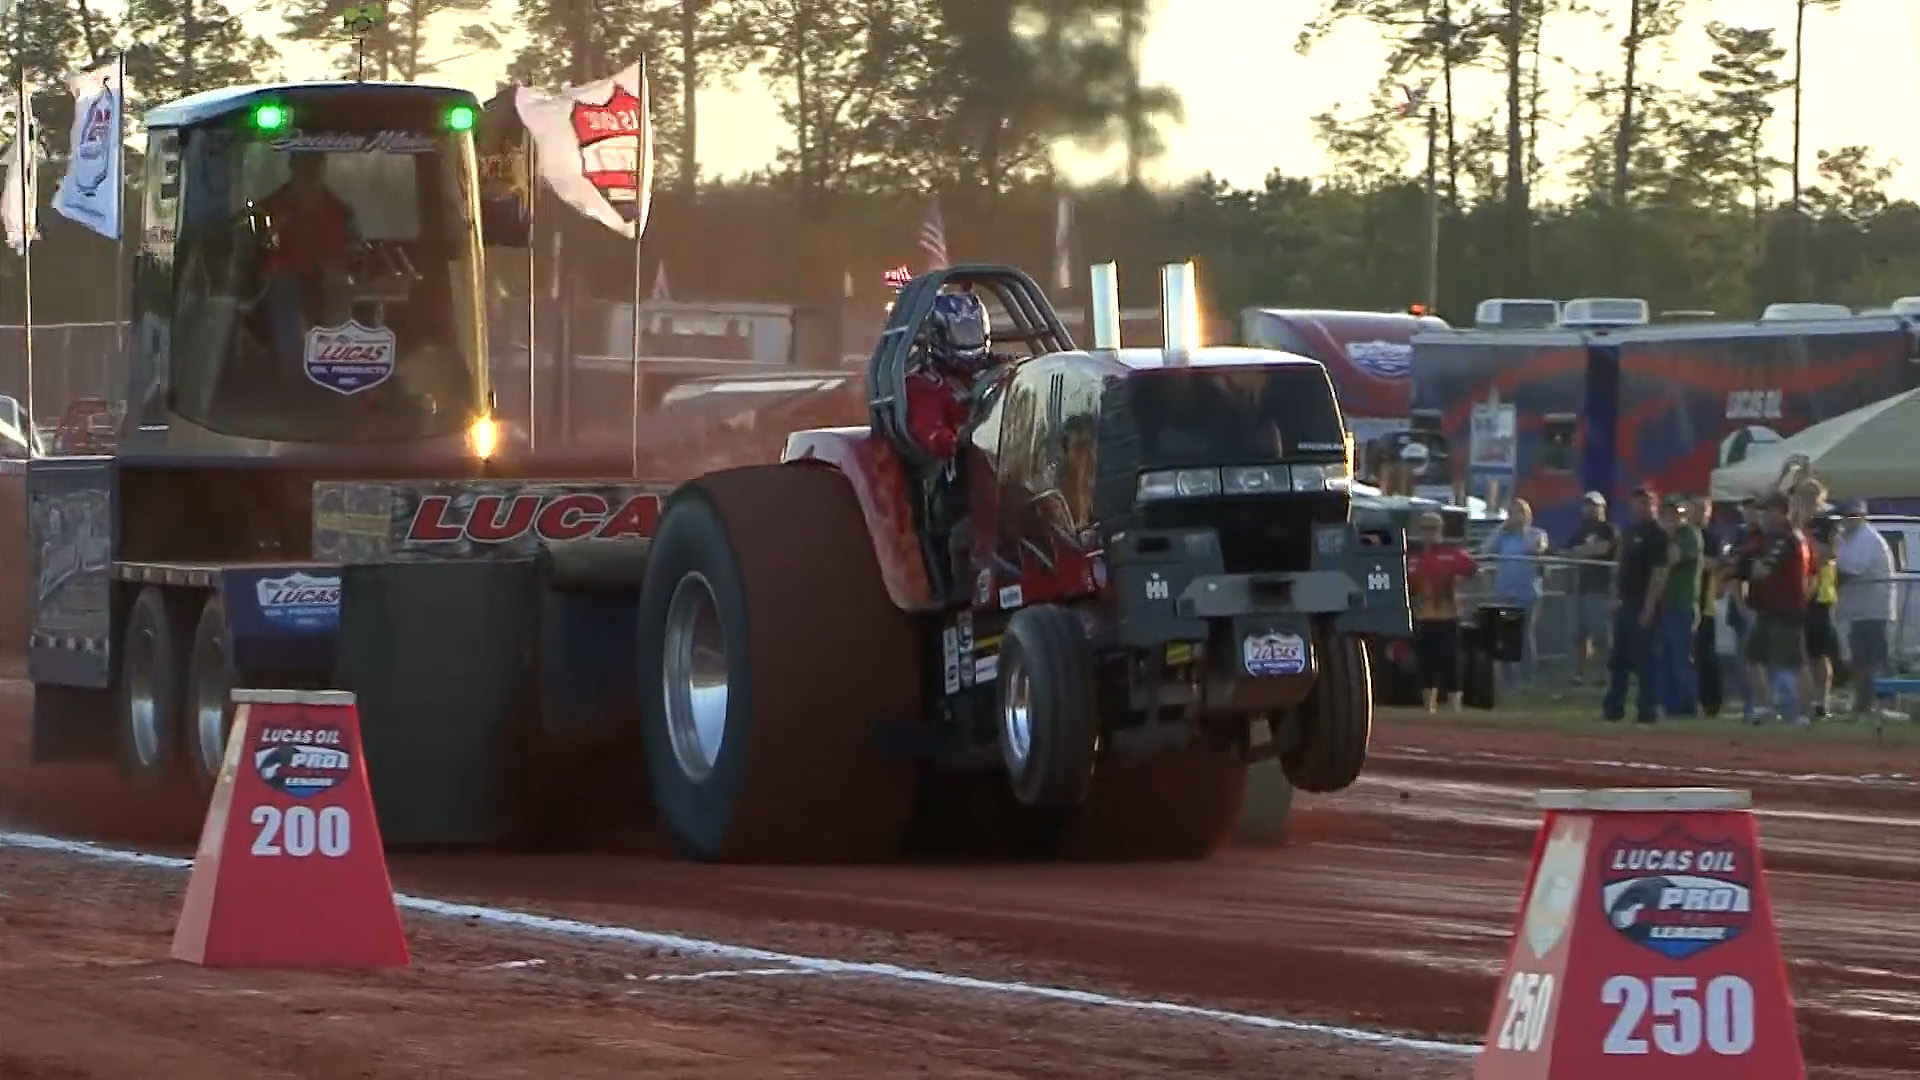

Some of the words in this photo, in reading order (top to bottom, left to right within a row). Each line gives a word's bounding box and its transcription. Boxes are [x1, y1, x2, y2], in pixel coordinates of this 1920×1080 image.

[317, 345, 388, 360] LUCAS
[268, 589, 341, 604] LUCAS
[261, 728, 313, 744] LUCAS
[315, 729, 340, 745] OIL
[290, 752, 340, 769] PRO
[251, 805, 351, 857] 200
[1611, 849, 1694, 871] LUCAS
[1697, 851, 1737, 872] OIL
[1658, 886, 1738, 911] PRO
[1496, 972, 1555, 1052] 250
[1601, 975, 1755, 1055] 250
